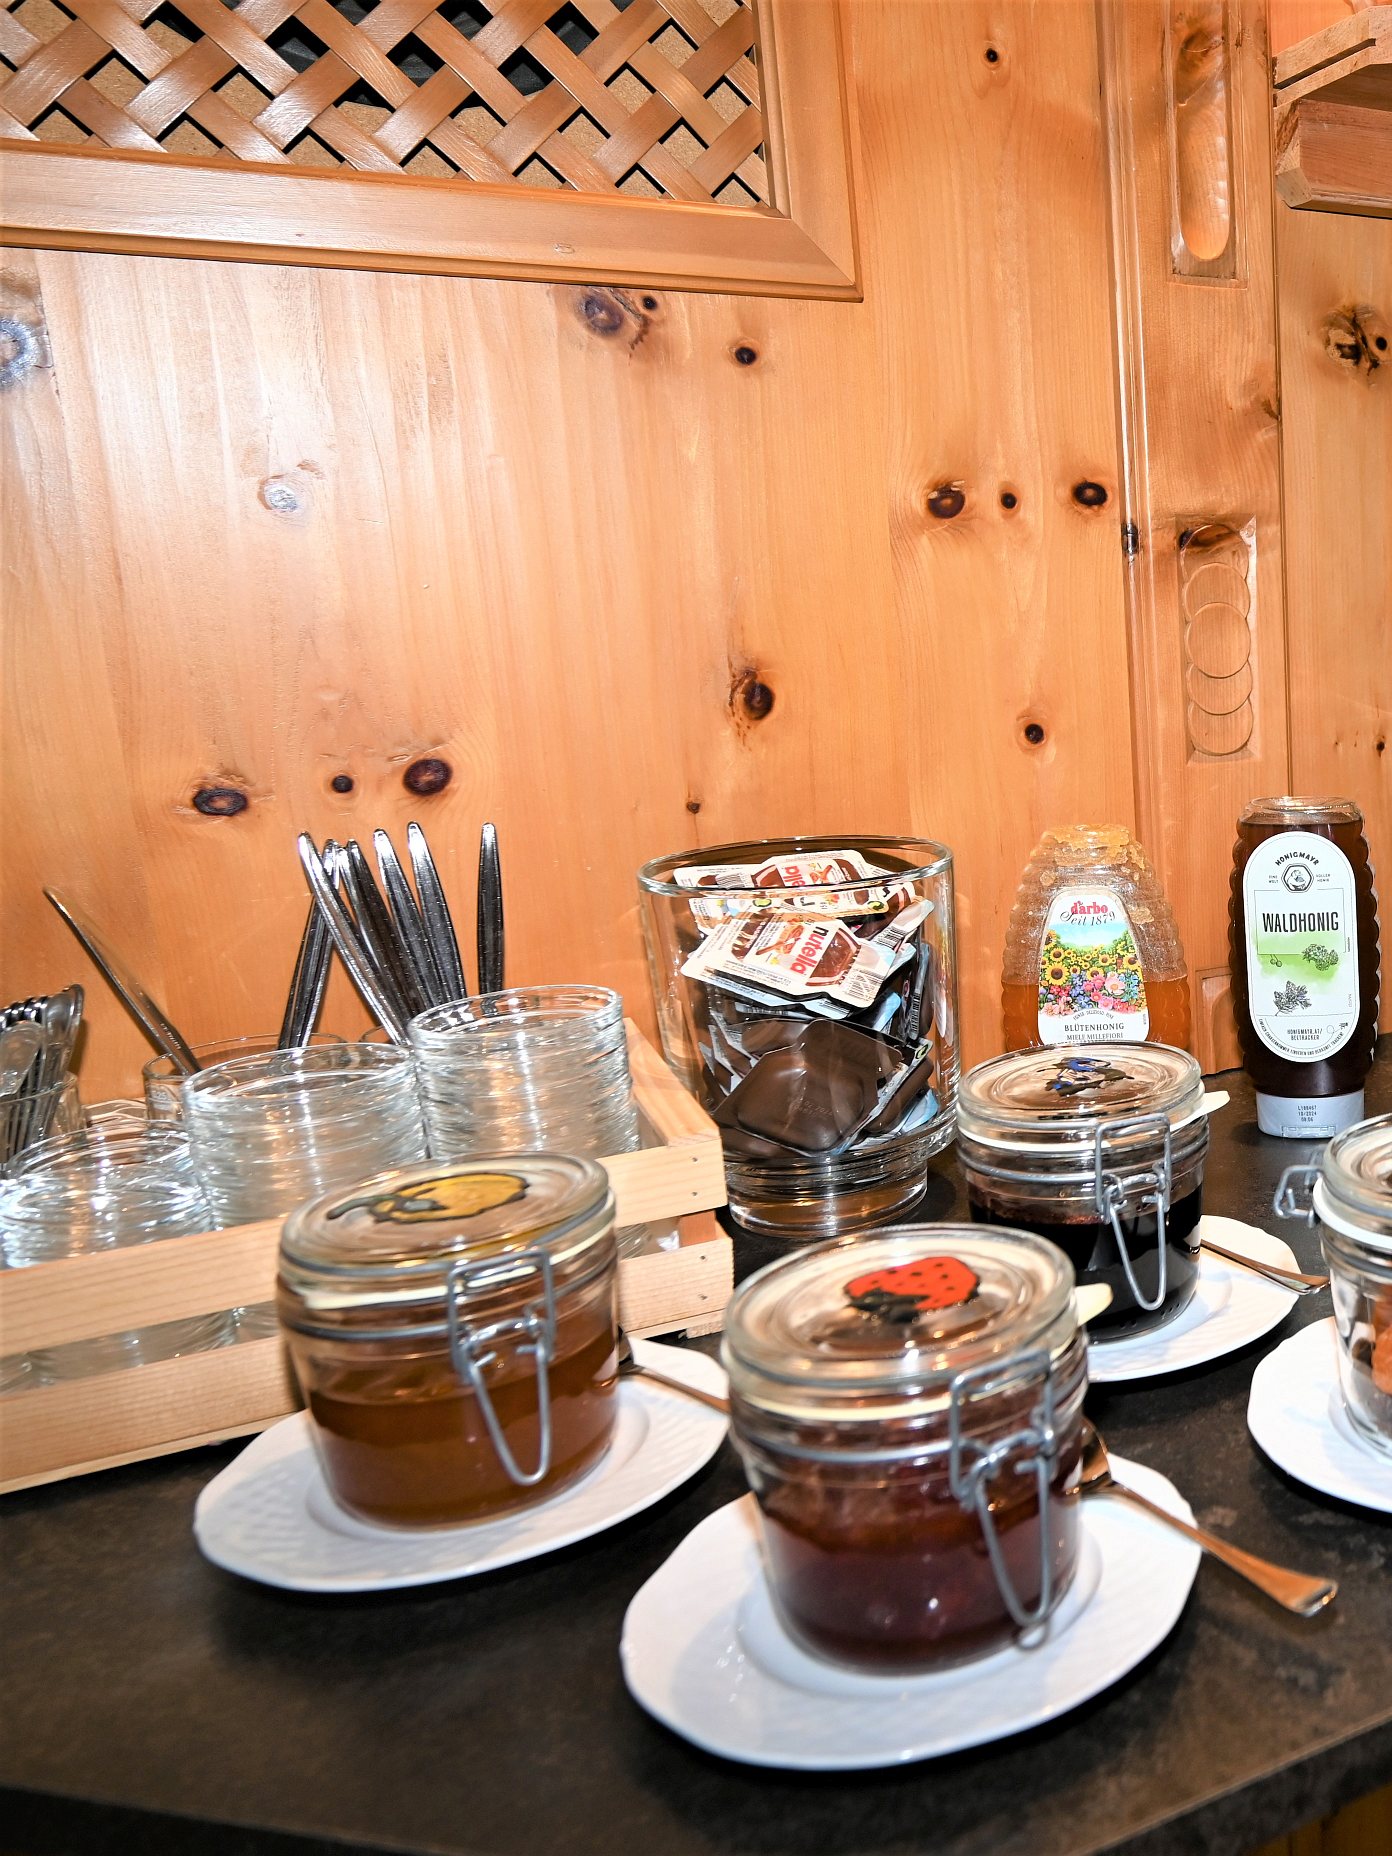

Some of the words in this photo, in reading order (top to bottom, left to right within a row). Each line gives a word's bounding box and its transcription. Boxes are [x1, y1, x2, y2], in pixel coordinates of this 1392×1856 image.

[1275, 851, 1320, 866] HONIGMAYR
[1060, 911, 1087, 926] Seit
[1091, 911, 1116, 926] 1879
[1262, 911, 1339, 933] WALDHONIG
[790, 926, 829, 975] nutella
[1064, 1022, 1124, 1032] BLÜTENHONIG
[1066, 1033, 1086, 1041] MIELE
[1087, 1032, 1124, 1040] MILLEFIORI
